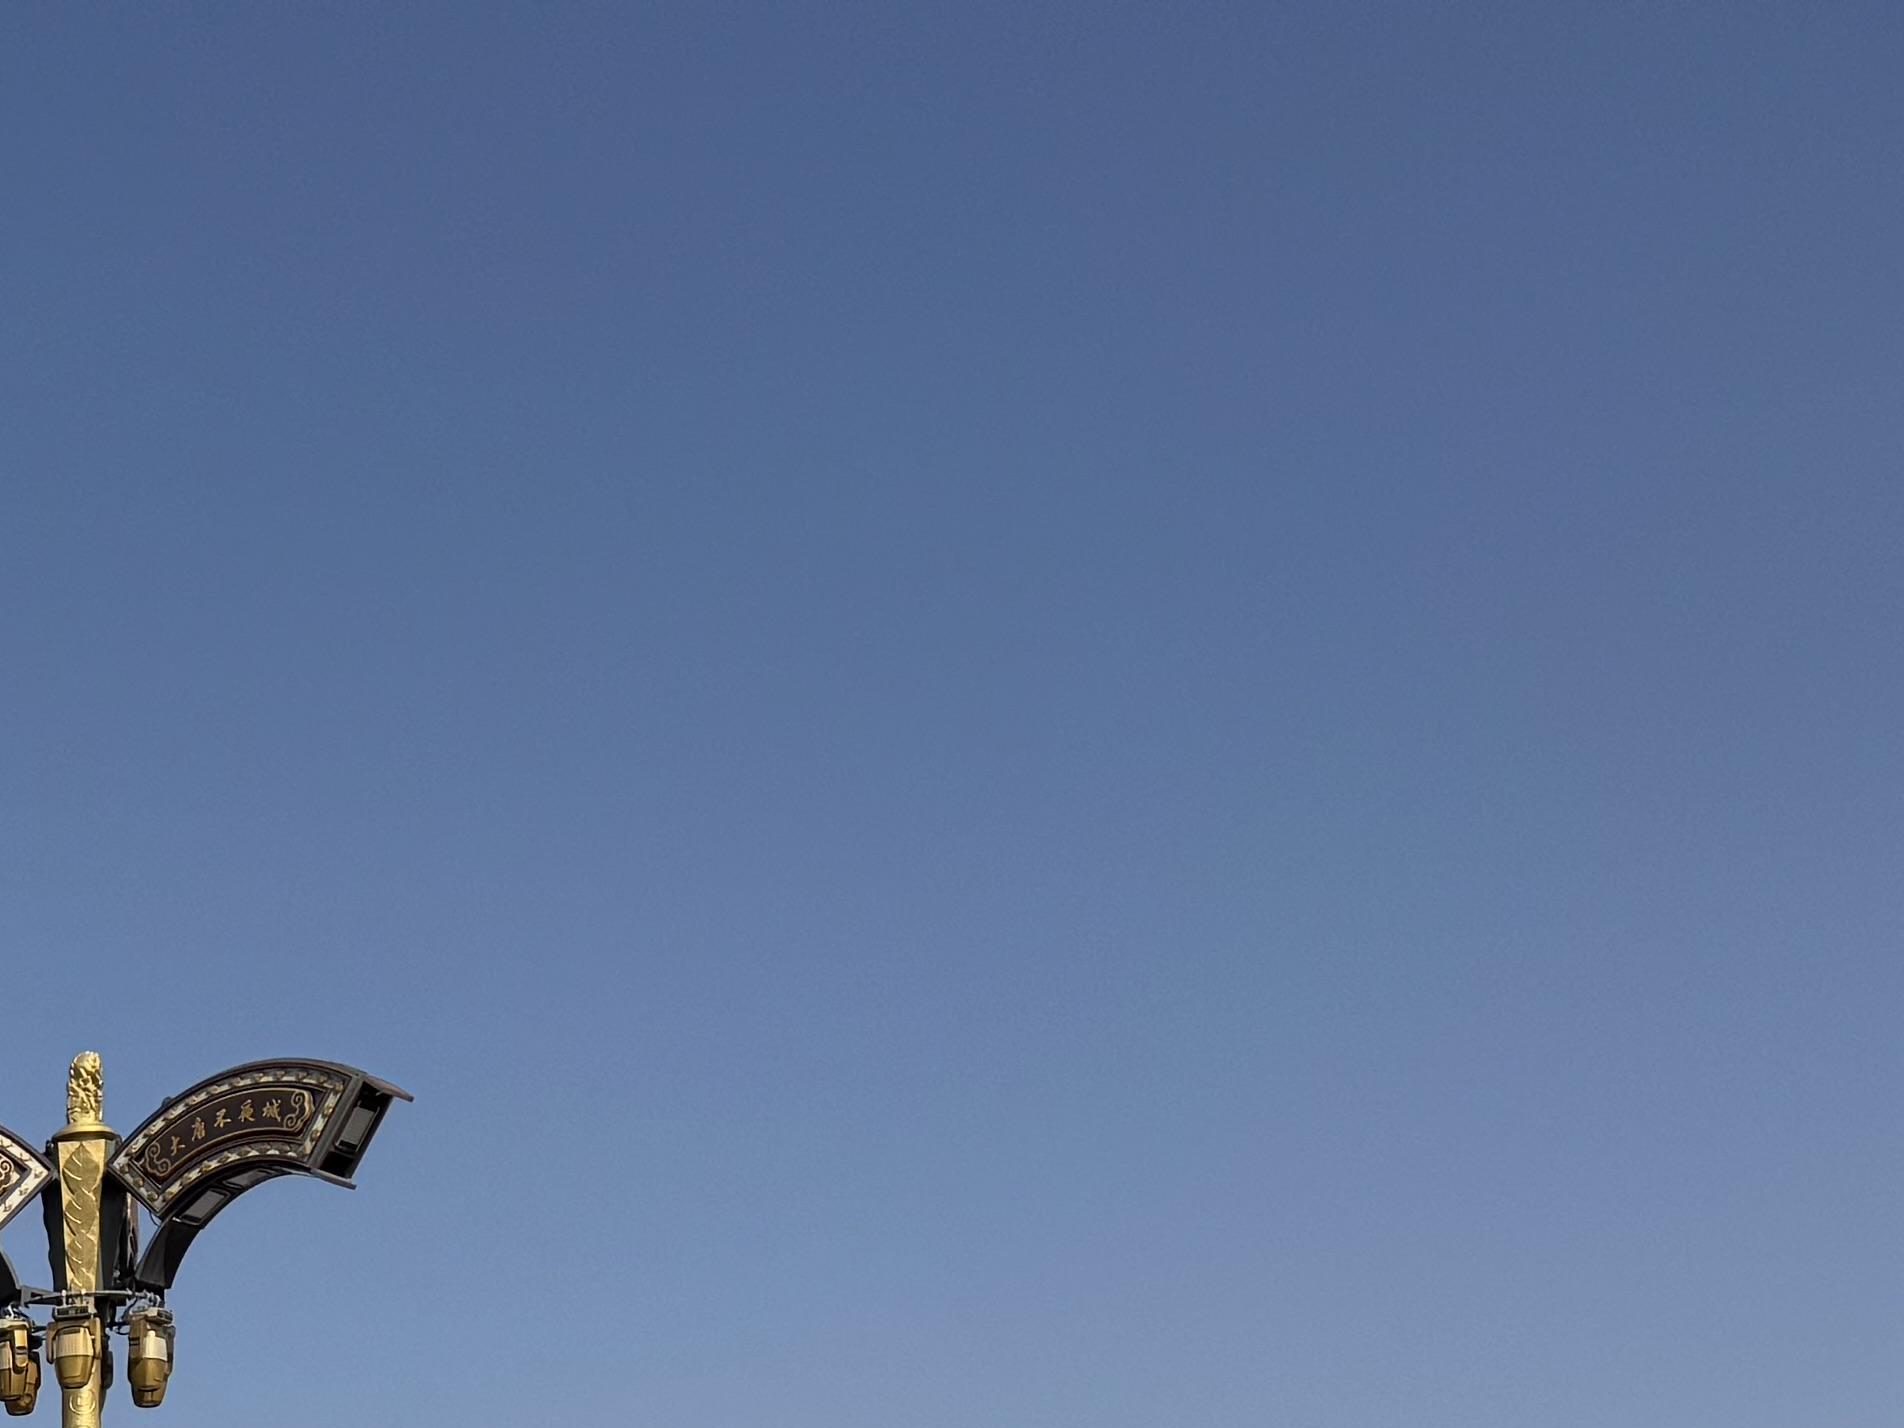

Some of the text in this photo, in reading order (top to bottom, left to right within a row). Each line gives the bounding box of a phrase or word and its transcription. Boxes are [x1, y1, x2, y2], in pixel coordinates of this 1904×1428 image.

[171, 1099, 281, 1156] 大唐不夜城
